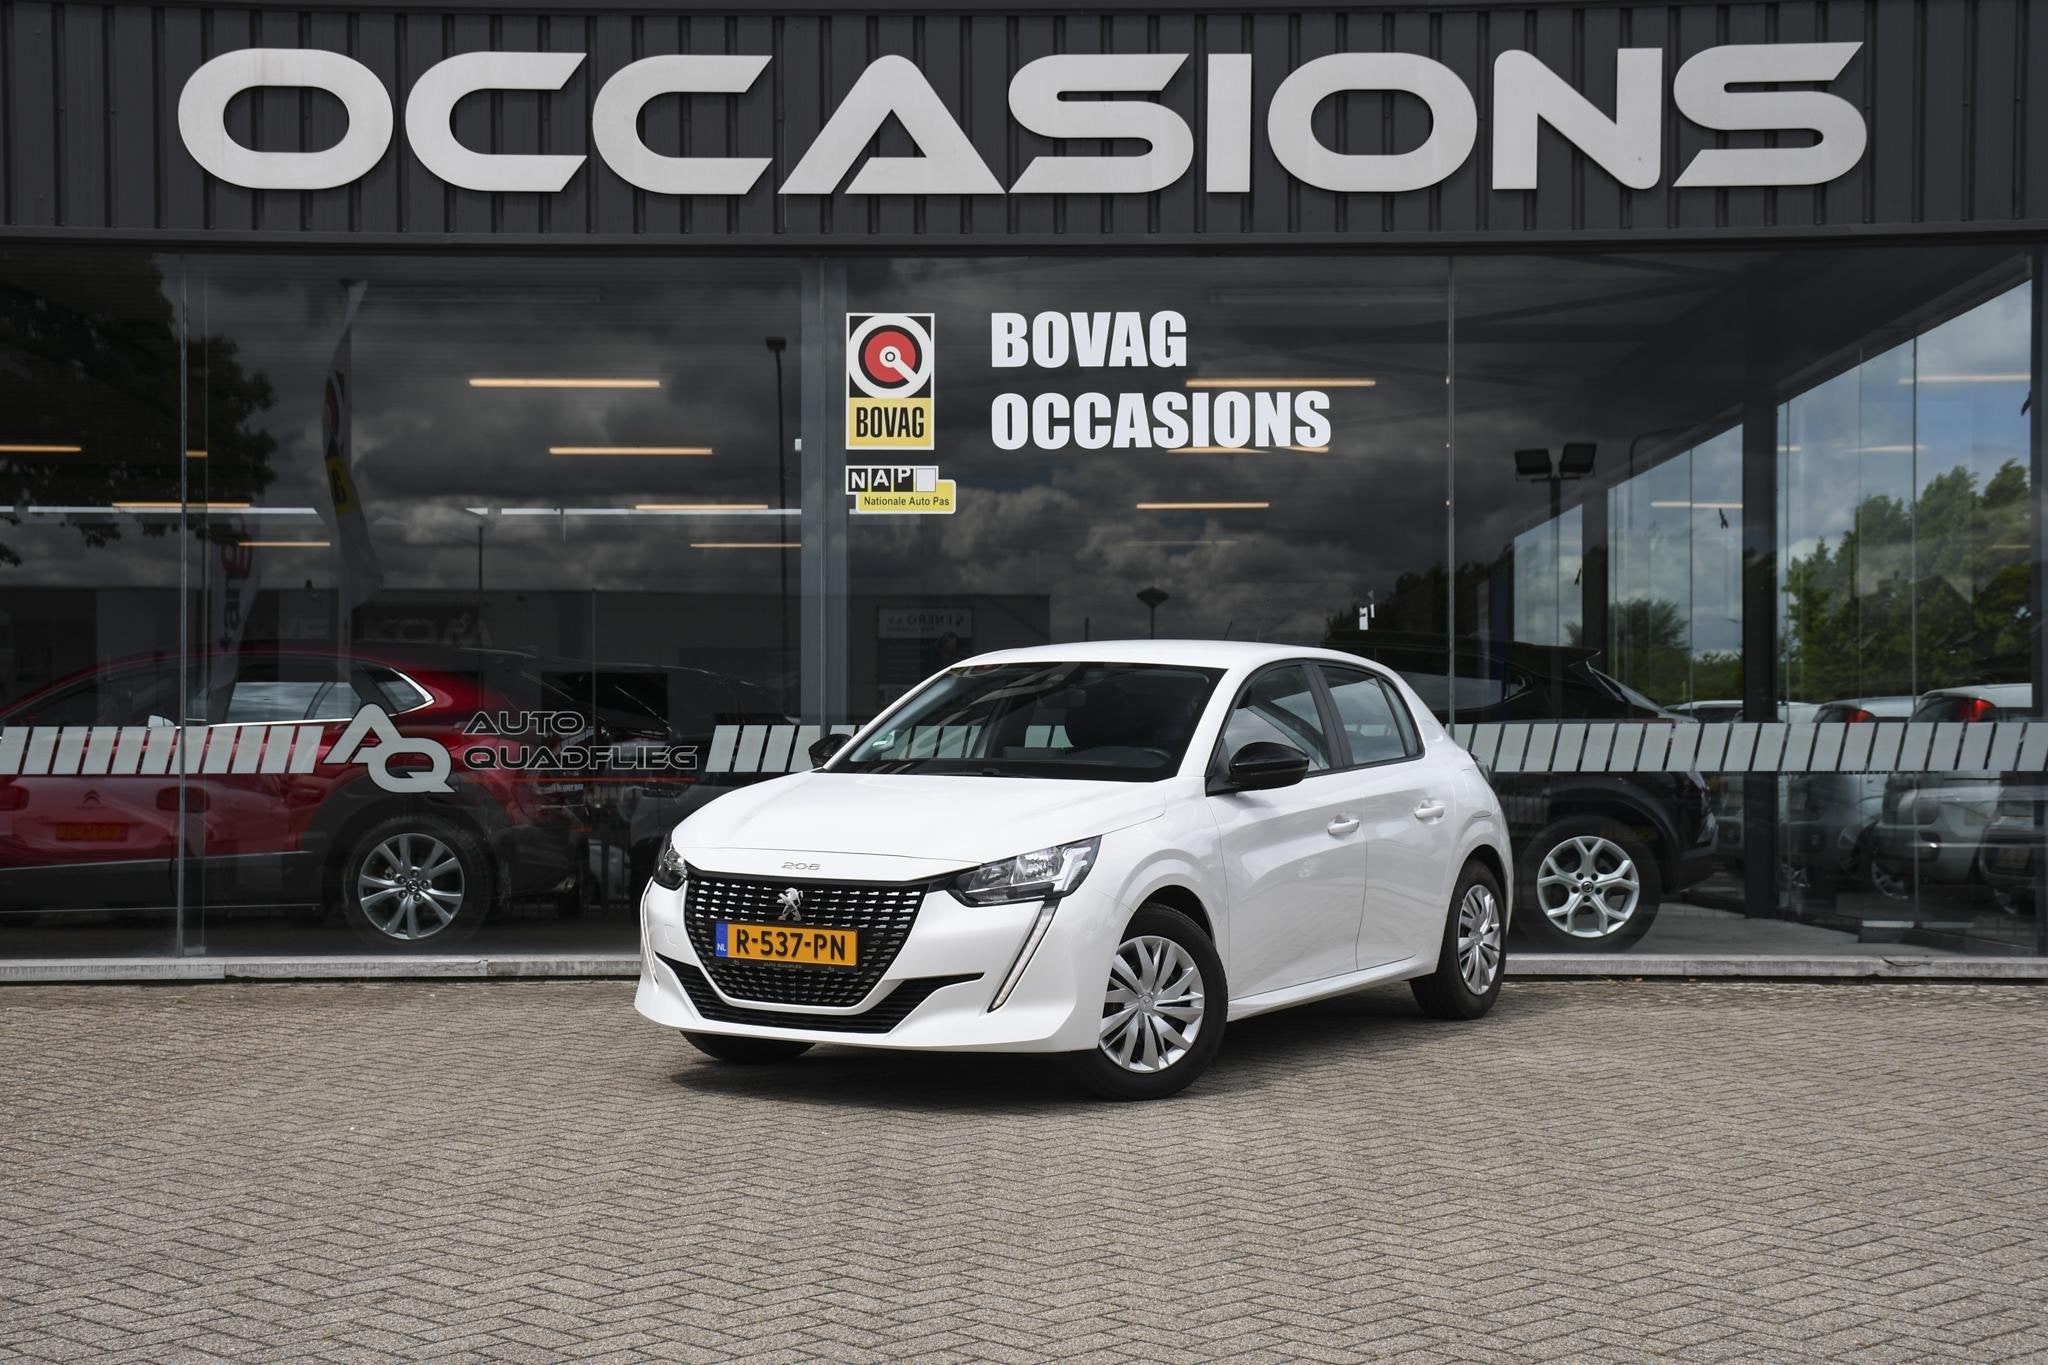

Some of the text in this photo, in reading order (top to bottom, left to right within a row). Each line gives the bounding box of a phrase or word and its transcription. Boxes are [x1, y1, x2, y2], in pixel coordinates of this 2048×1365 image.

[178, 41, 1867, 196] OCCASIONS
[991, 310, 1187, 369] BOVAG
[856, 406, 925, 439] BOVAG
[991, 390, 1332, 451] OCCASIONS
[851, 467, 911, 489] NAP
[864, 496, 950, 506] Nationale Auto Pas
[462, 711, 585, 736] AUTO
[462, 745, 699, 771] QUADFLIEG
[717, 928, 846, 961] NL R-537-PN
